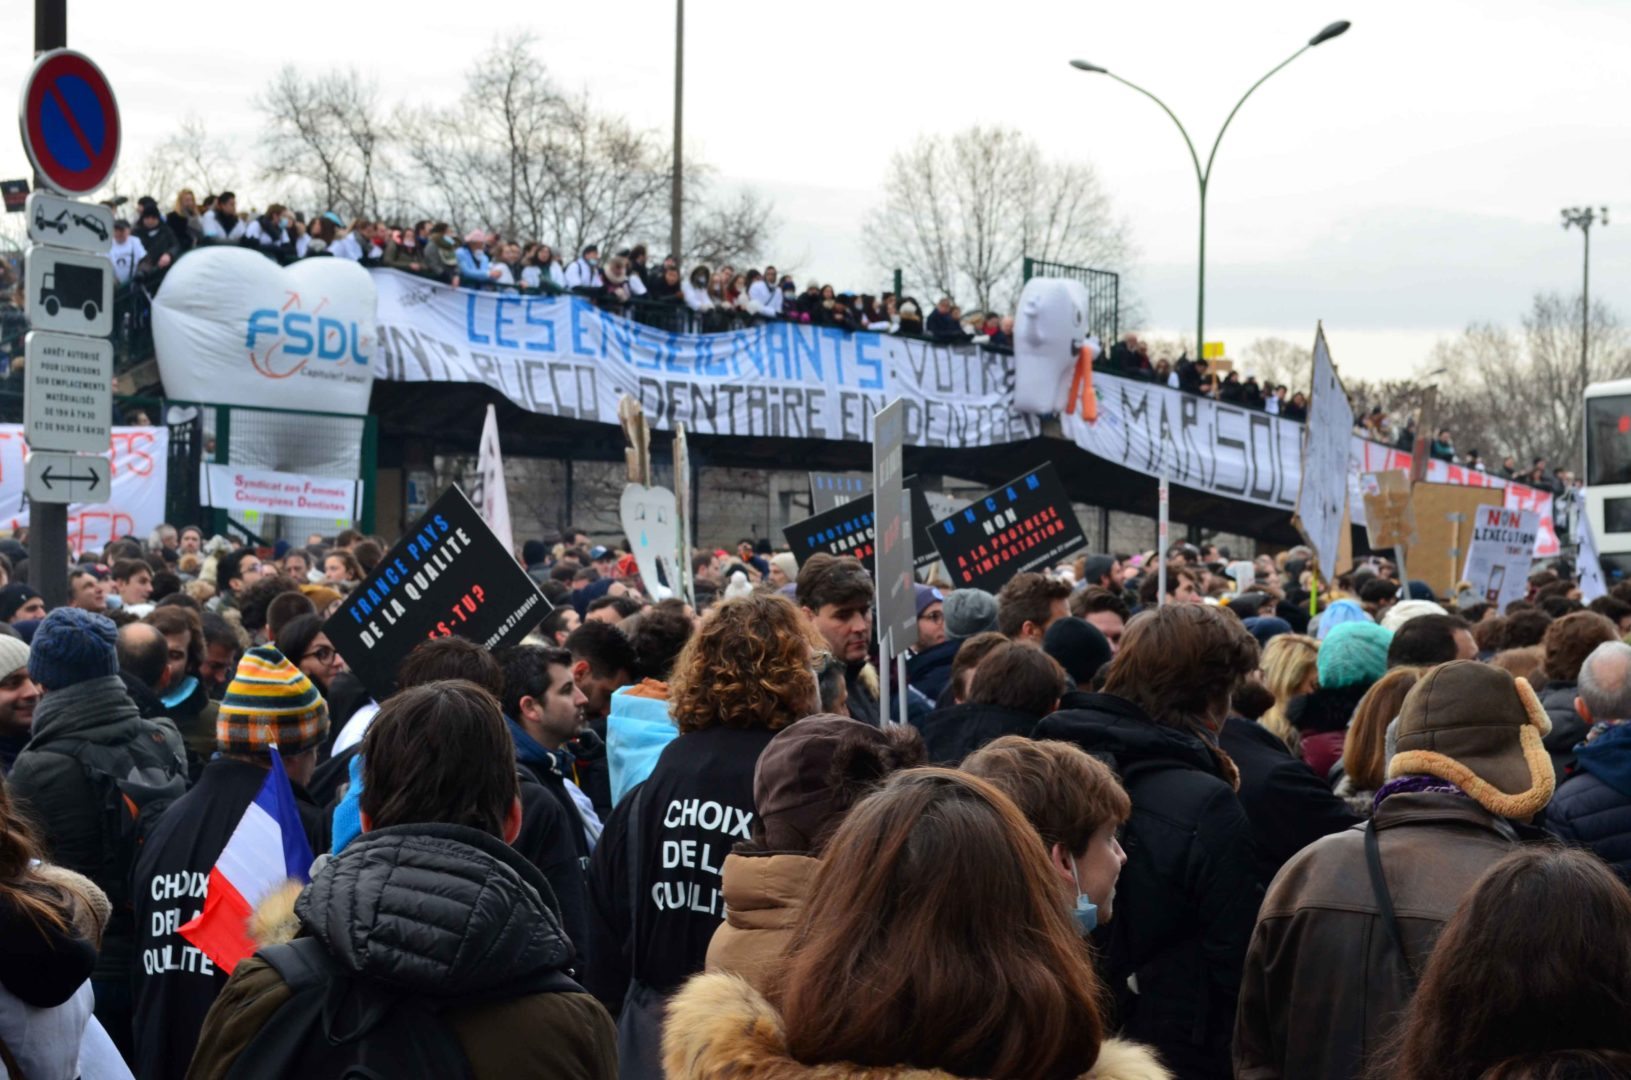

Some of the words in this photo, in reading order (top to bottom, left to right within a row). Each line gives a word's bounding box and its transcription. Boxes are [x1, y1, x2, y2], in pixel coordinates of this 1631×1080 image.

[466, 292, 556, 352] LES
[245, 309, 369, 366] FSDL
[41, 362, 59, 371] POUR
[61, 364, 101, 376] LIVRAISONS
[43, 347, 65, 357] ARRÊT
[67, 350, 100, 361] AUTORISÉ
[36, 376, 49, 385] SUR
[51, 378, 106, 392] EMPLACEMENTS
[46, 393, 95, 405] MATÉRIALISÉS
[34, 421, 43, 430] ET
[45, 422, 54, 431] DE
[45, 407, 54, 416] DE
[839, 391, 886, 443] EN
[234, 474, 282, 491] Syndicat
[304, 481, 345, 497] Femmes
[235, 490, 294, 508] Chirurgiens
[298, 496, 345, 511] Dentistes
[943, 474, 1040, 535] UNCAM
[1487, 509, 1522, 529] NON
[970, 544, 988, 562] LA
[991, 505, 1058, 549] PROTHESE
[982, 507, 1018, 536] NON
[829, 529, 875, 555] FRANC
[349, 558, 409, 624] FRANCE
[407, 514, 449, 561] PAYS
[359, 621, 384, 649] DE
[382, 598, 406, 626] LA
[404, 527, 472, 602] QUALITE
[498, 624, 509, 637] du
[506, 614, 517, 628] 27
[513, 593, 539, 621] janvier
[663, 798, 754, 840] CHOIX
[662, 840, 697, 868] DE
[700, 843, 724, 876] L
[151, 870, 210, 901] CHOIX
